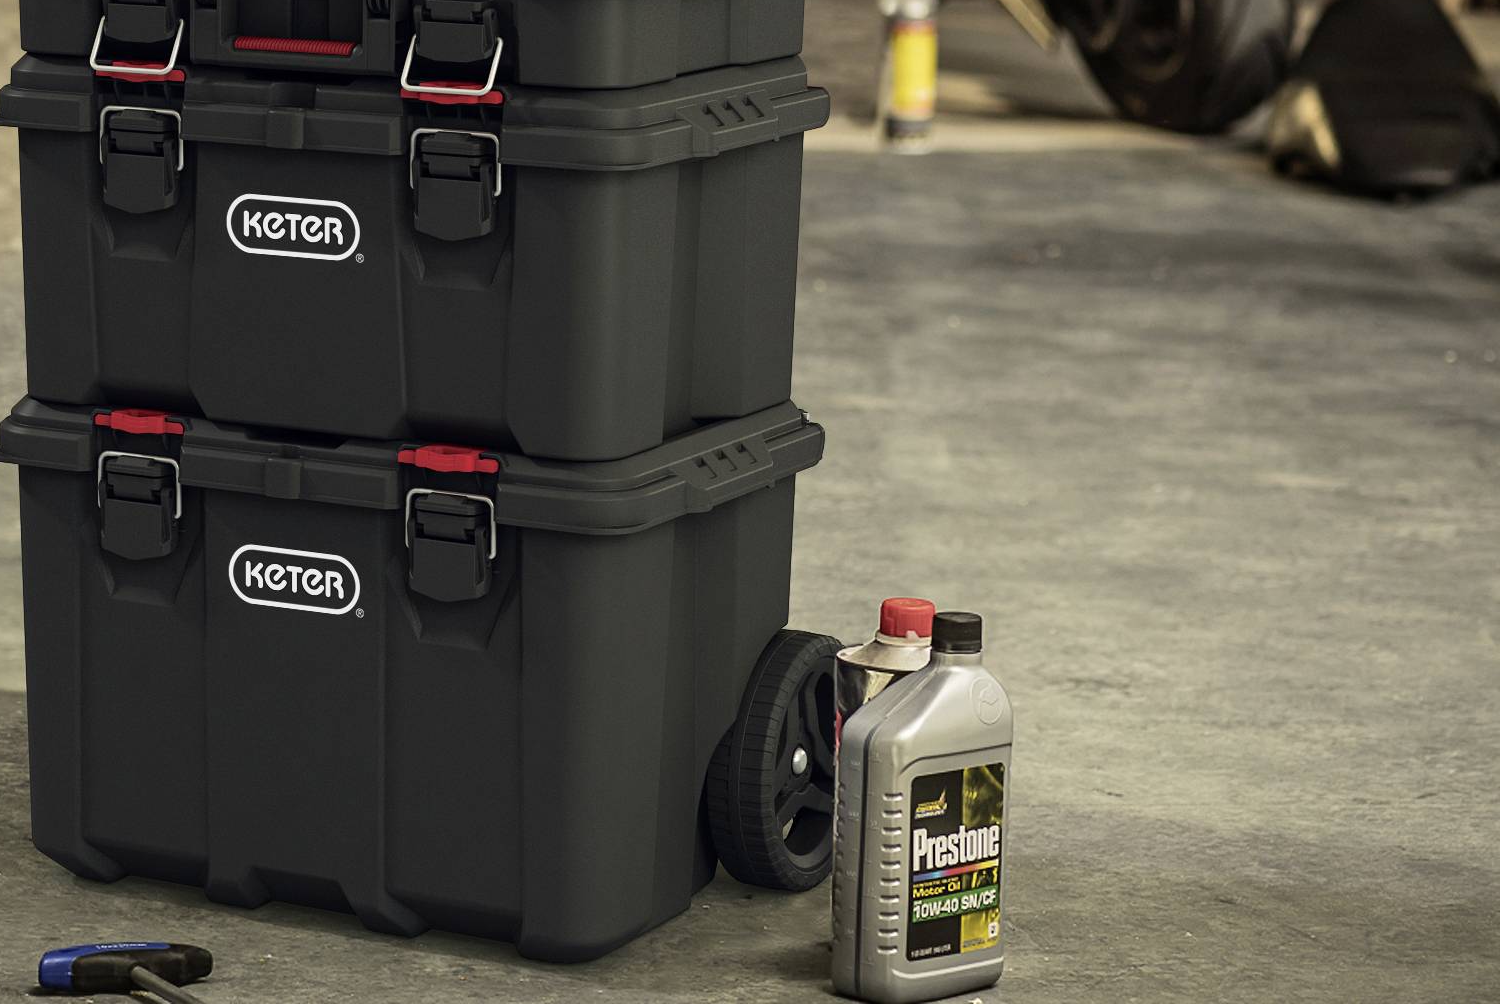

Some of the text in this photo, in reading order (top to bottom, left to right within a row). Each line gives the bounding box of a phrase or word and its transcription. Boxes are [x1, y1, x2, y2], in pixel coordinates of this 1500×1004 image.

[912, 825, 999, 871] Prestone
[912, 886, 946, 899] Motor
[947, 881, 961, 892] Oil
[912, 889, 997, 919] 10W-40 SN/CF
